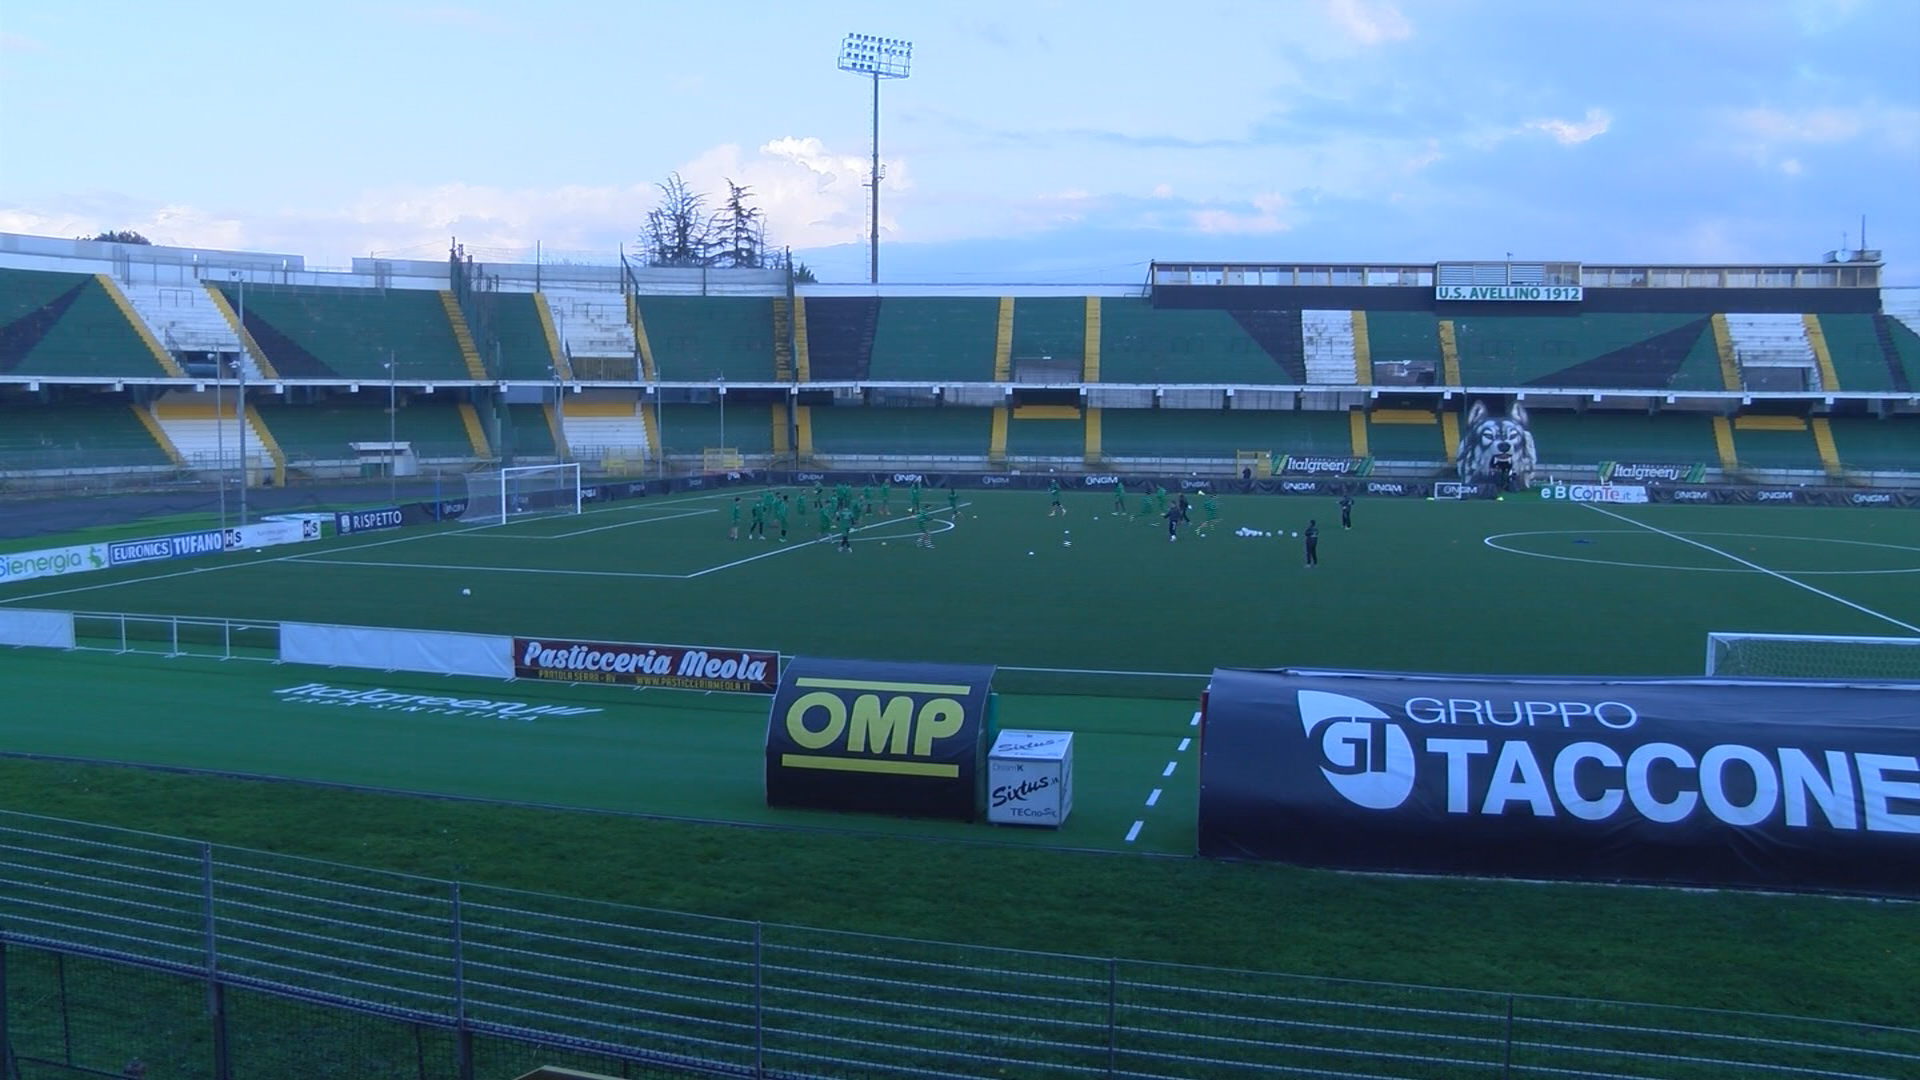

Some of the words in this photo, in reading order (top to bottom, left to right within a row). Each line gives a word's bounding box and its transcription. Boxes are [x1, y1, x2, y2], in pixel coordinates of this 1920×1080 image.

[1438, 287, 1467, 299] U.S.
[1469, 287, 1541, 299] AVELLINO
[1544, 287, 1580, 300] 1912
[352, 511, 403, 529] RISPETTO
[115, 542, 169, 561] EURONICS
[173, 533, 222, 556] TUFANO
[523, 641, 673, 676] Pasticceria
[677, 651, 768, 681] Meola
[786, 692, 965, 757] OMP
[1403, 696, 1638, 730] GRUPPO
[1426, 738, 1920, 834] TACCONE
